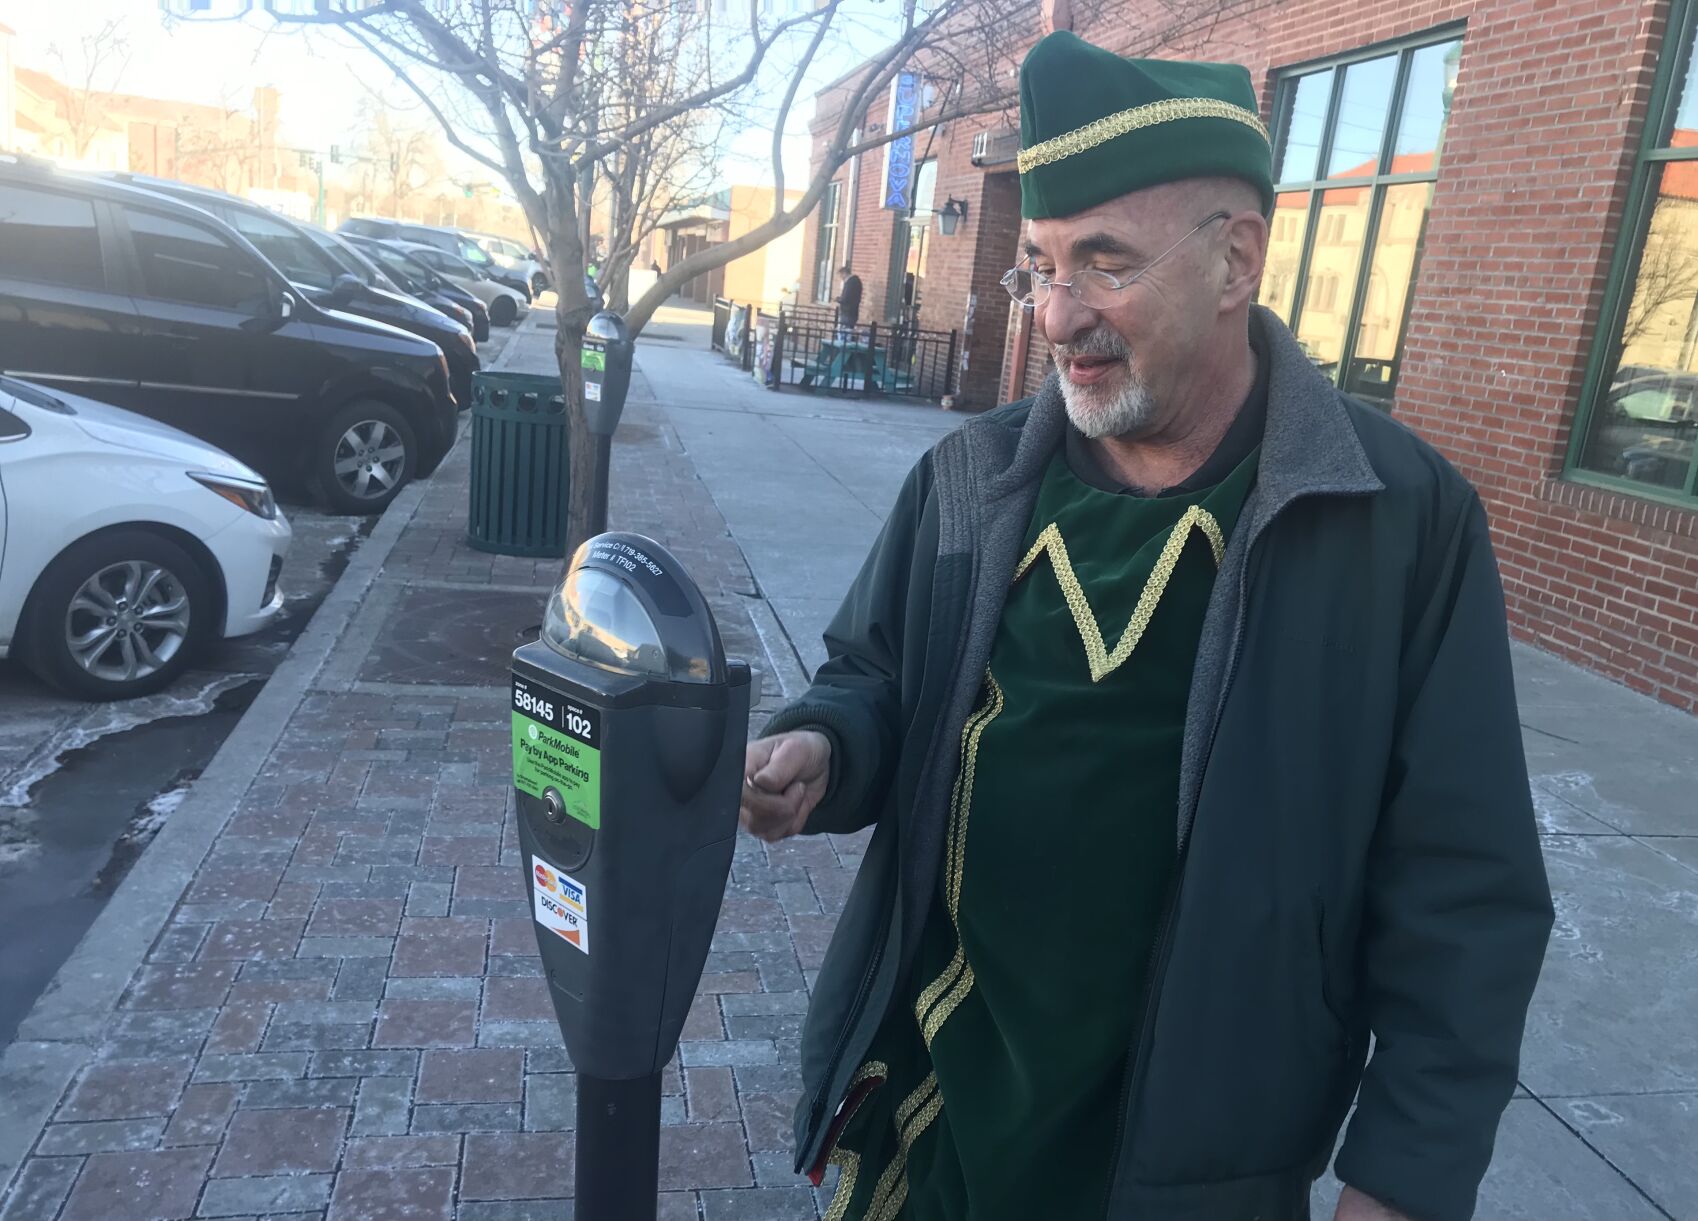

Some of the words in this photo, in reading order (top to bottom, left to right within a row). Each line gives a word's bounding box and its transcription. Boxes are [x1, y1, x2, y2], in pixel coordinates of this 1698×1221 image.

[592, 550, 610, 560] Meter
[616, 556, 636, 572] TF102
[624, 546, 663, 576] 719-385-5627
[515, 688, 554, 720] 58145
[566, 712, 592, 738] 102
[538, 731, 580, 758] ParkMobile
[520, 737, 532, 754] Pay
[533, 746, 542, 759] by
[544, 750, 558, 766] App
[558, 758, 589, 782] Parking
[562, 884, 581, 904] VISA
[542, 896, 578, 928] DISCOVER
